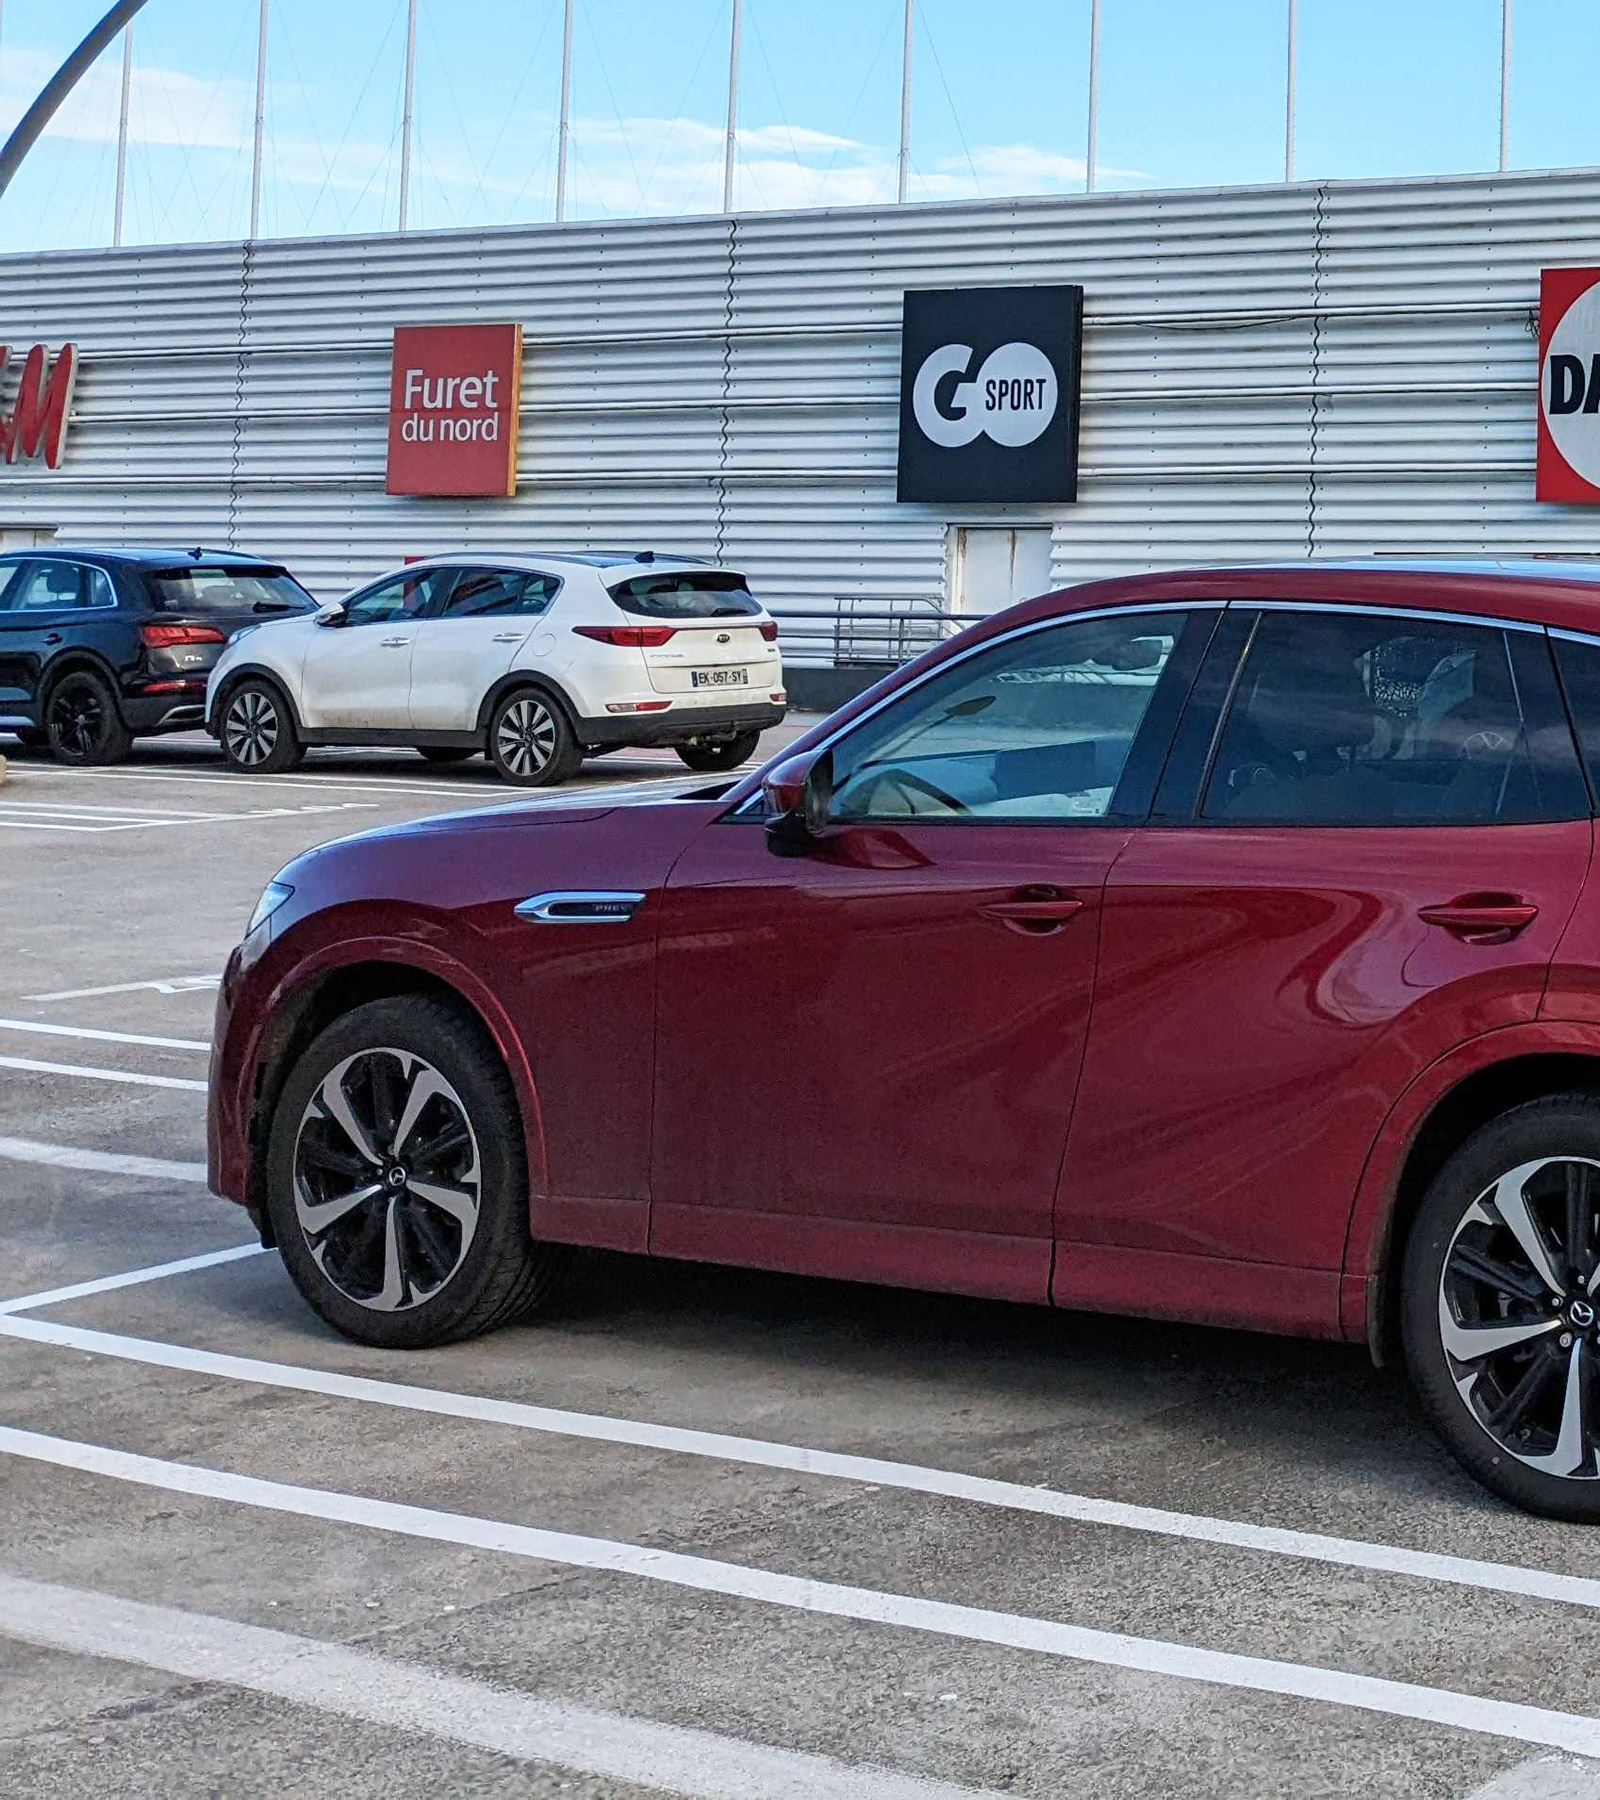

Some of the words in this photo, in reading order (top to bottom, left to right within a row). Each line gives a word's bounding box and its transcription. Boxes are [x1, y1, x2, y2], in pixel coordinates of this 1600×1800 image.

[404, 369, 499, 409] Furet
[912, 341, 1058, 448] GO
[984, 378, 1047, 411] SPORT
[402, 412, 434, 441] du
[439, 411, 498, 441] nord
[698, 671, 742, 684] EK-057-SY
